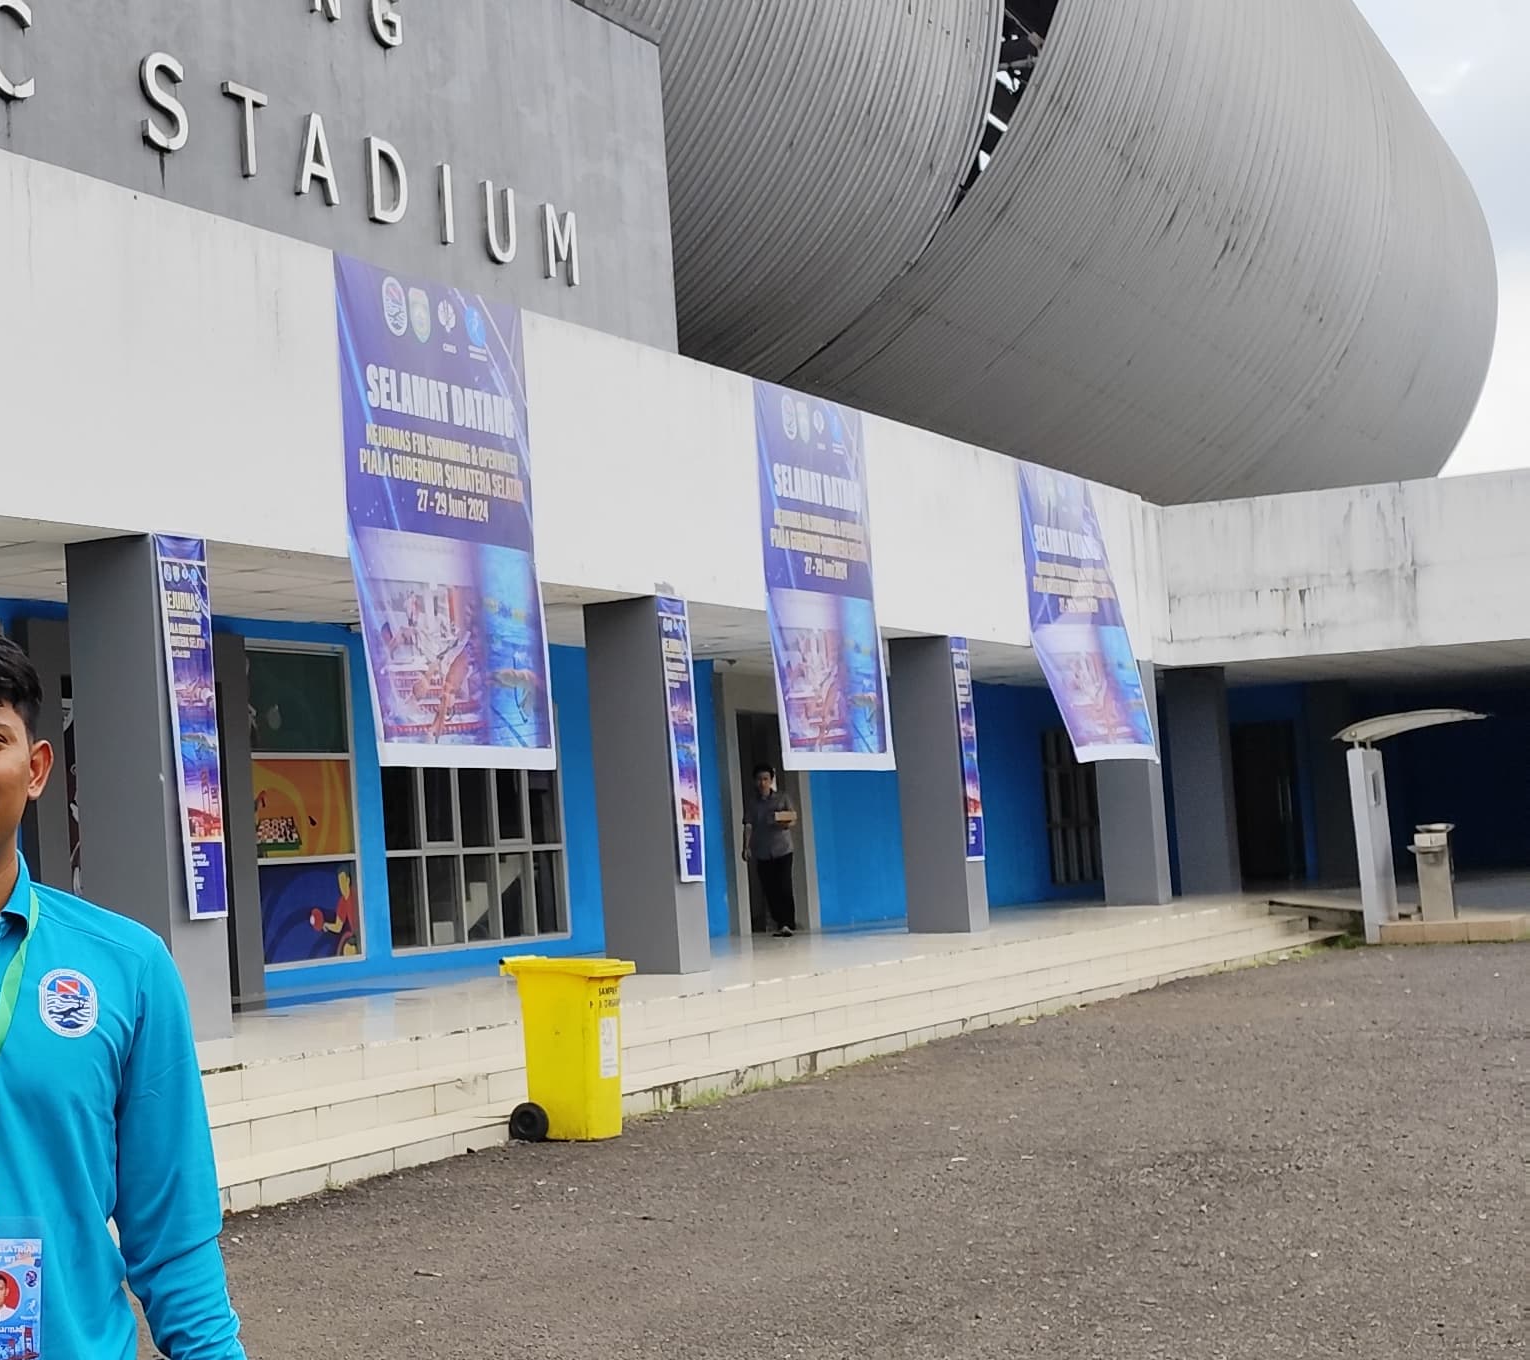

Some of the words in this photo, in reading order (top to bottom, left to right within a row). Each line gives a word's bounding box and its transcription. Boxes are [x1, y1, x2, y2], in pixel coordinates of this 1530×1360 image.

[140, 51, 582, 287] STADIUM
[366, 363, 449, 424] SELAMAT
[359, 448, 391, 478] PIALA
[392, 453, 443, 485] GUBERNUR
[445, 464, 491, 494] SUMATERA
[417, 489, 428, 512] 27
[435, 492, 448, 516] 29
[448, 493, 467, 520] Juni
[468, 498, 489, 523] 2024
